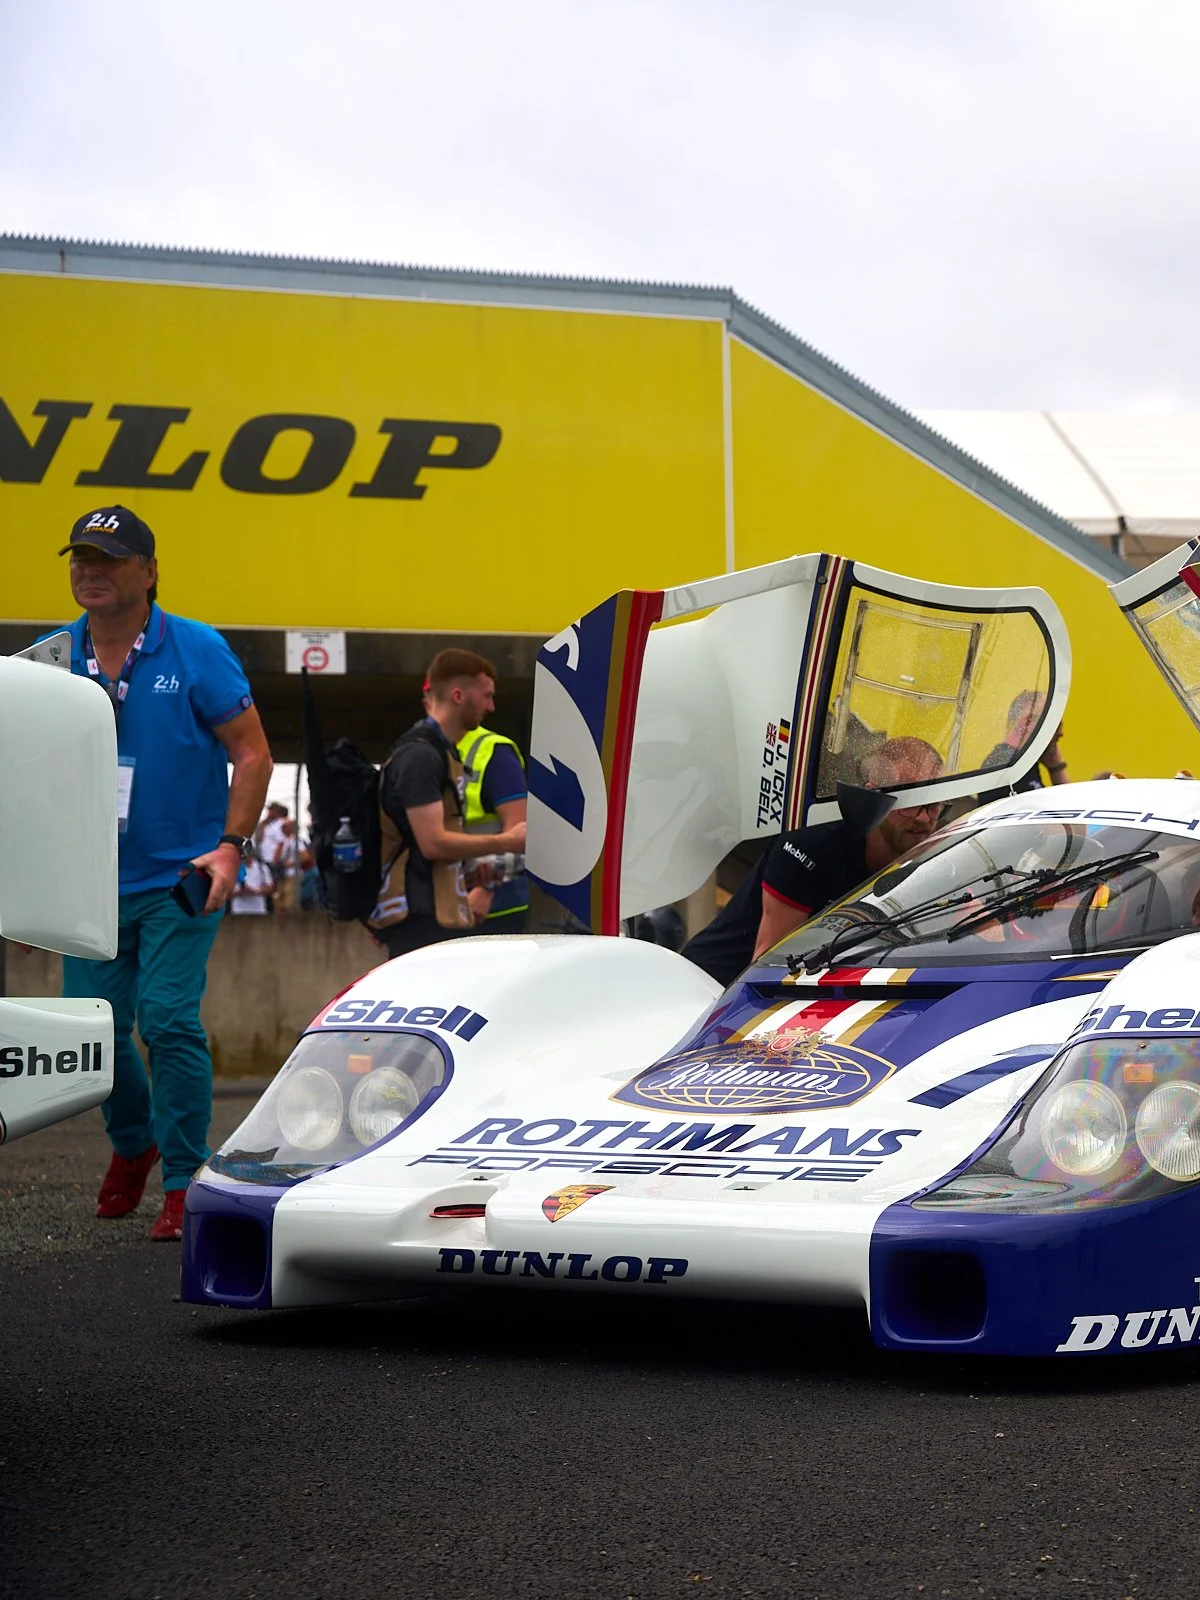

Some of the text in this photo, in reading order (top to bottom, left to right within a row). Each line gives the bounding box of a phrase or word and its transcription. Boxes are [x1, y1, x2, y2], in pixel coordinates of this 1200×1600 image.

[757, 747, 774, 829] D. BELL
[770, 744, 787, 825] J. ICKX
[783, 841, 808, 863] Mobil
[325, 1000, 488, 1042] Shell
[0, 1042, 102, 1079] Shell
[647, 1061, 846, 1096] Rothmans
[450, 1117, 922, 1157] ROTHMANS
[406, 1154, 875, 1183] PORSCHE
[436, 1248, 689, 1285] DUNLOP
